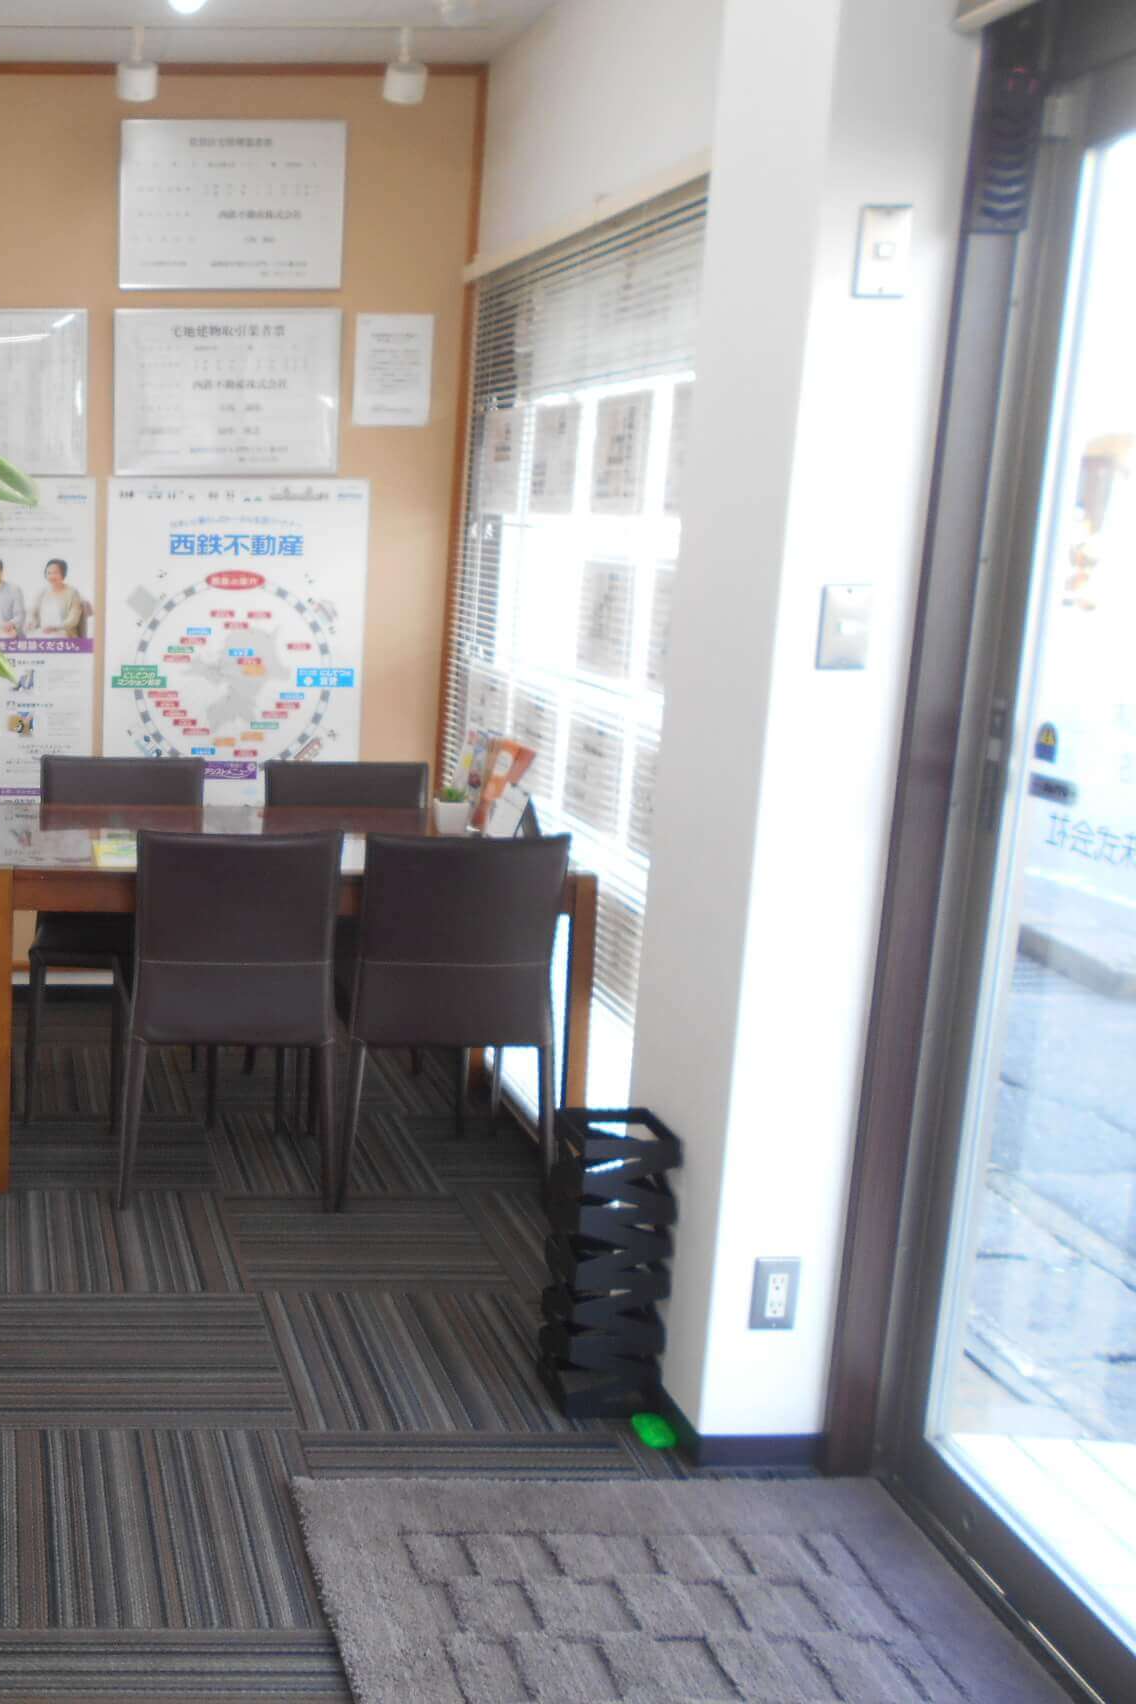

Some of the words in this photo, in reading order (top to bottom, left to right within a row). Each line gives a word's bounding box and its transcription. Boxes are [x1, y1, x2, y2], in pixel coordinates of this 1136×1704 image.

[169, 533, 304, 556] 西鉄不動産
